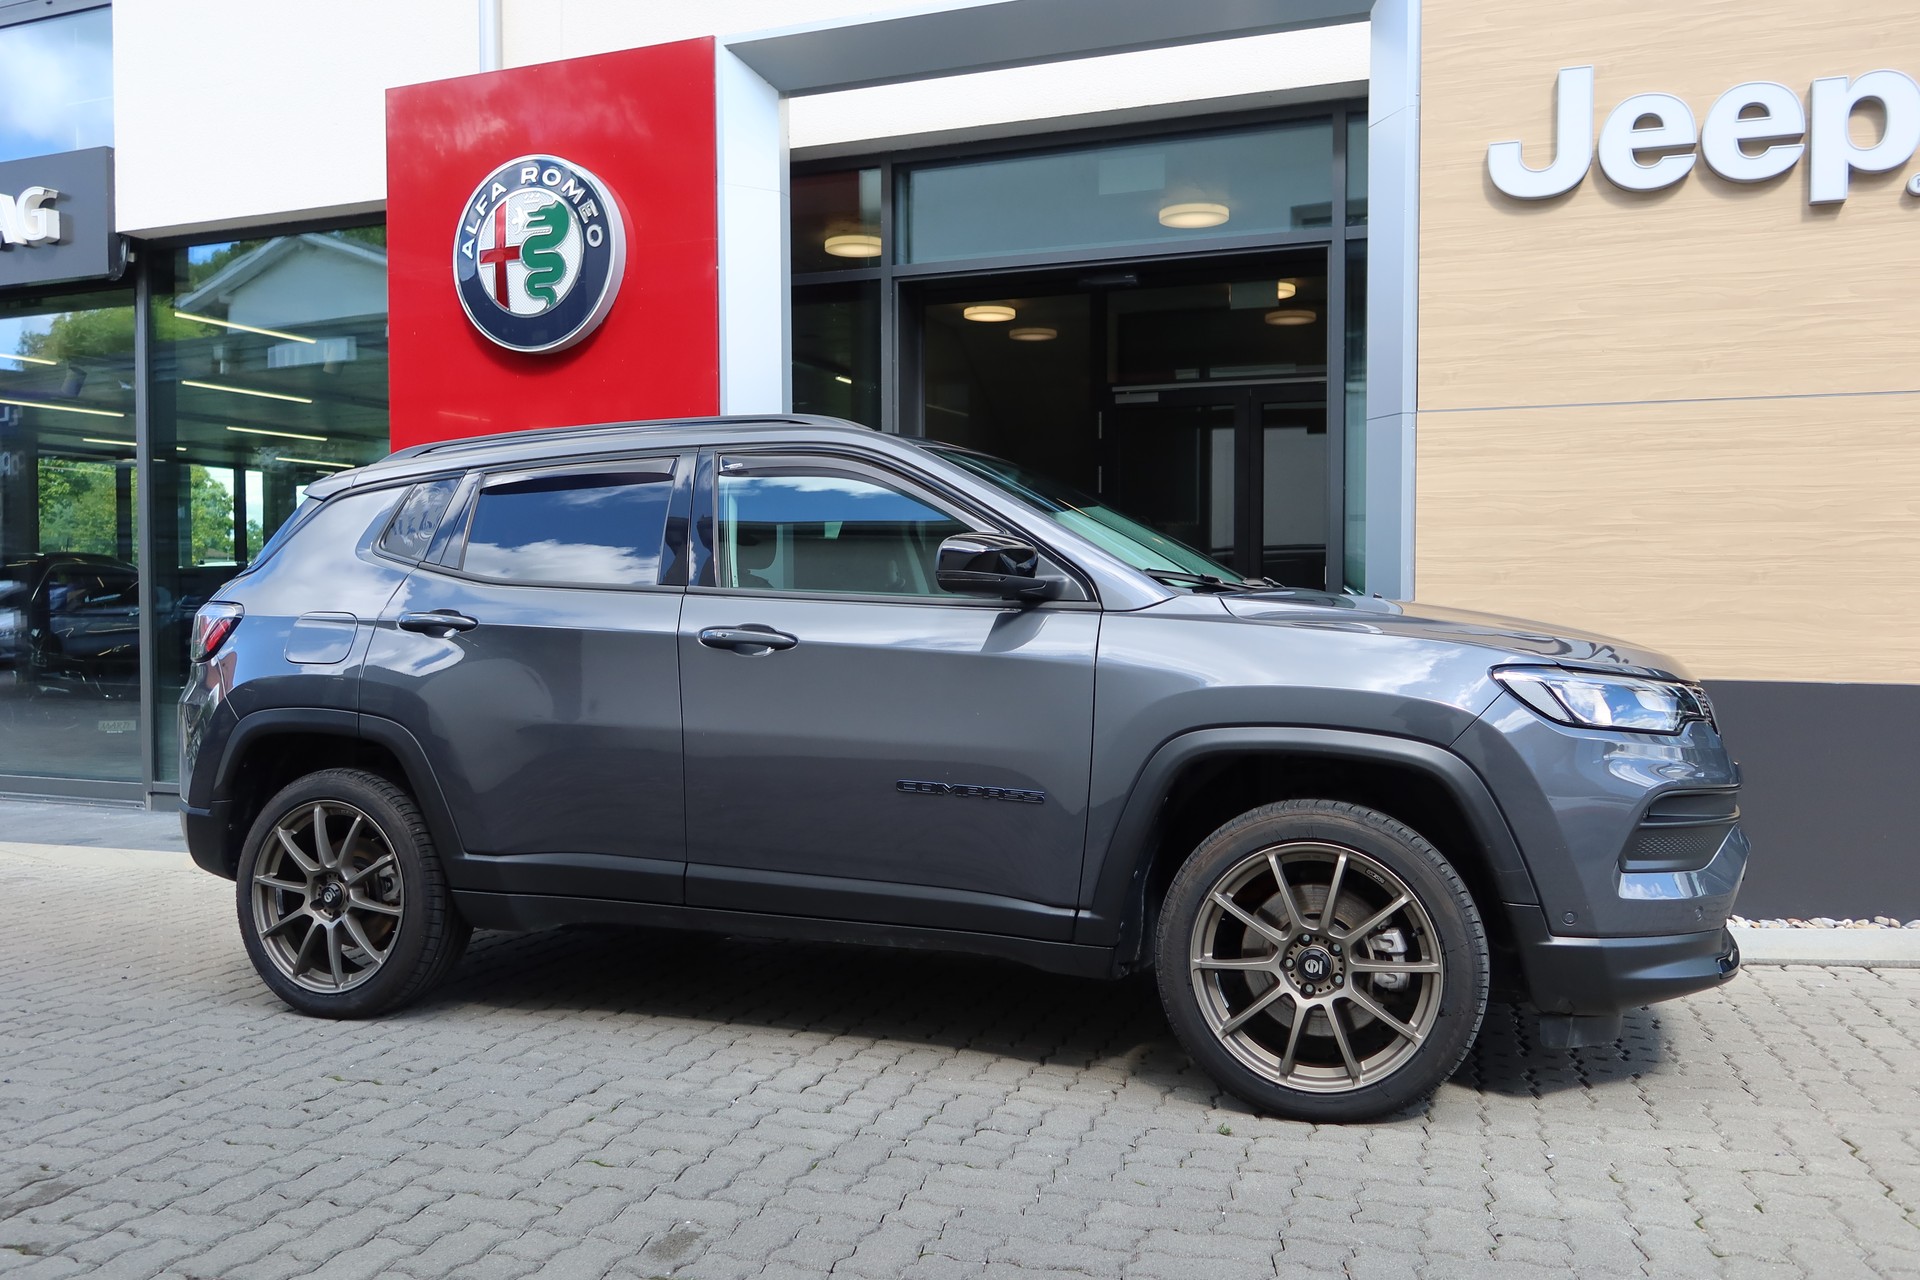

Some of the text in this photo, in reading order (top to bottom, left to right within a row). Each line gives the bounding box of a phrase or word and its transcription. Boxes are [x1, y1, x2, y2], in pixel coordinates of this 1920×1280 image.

[1487, 64, 1920, 206] Jeep
[461, 166, 603, 259] ALFA ROMEO
[896, 779, 1045, 804] COMPASS
